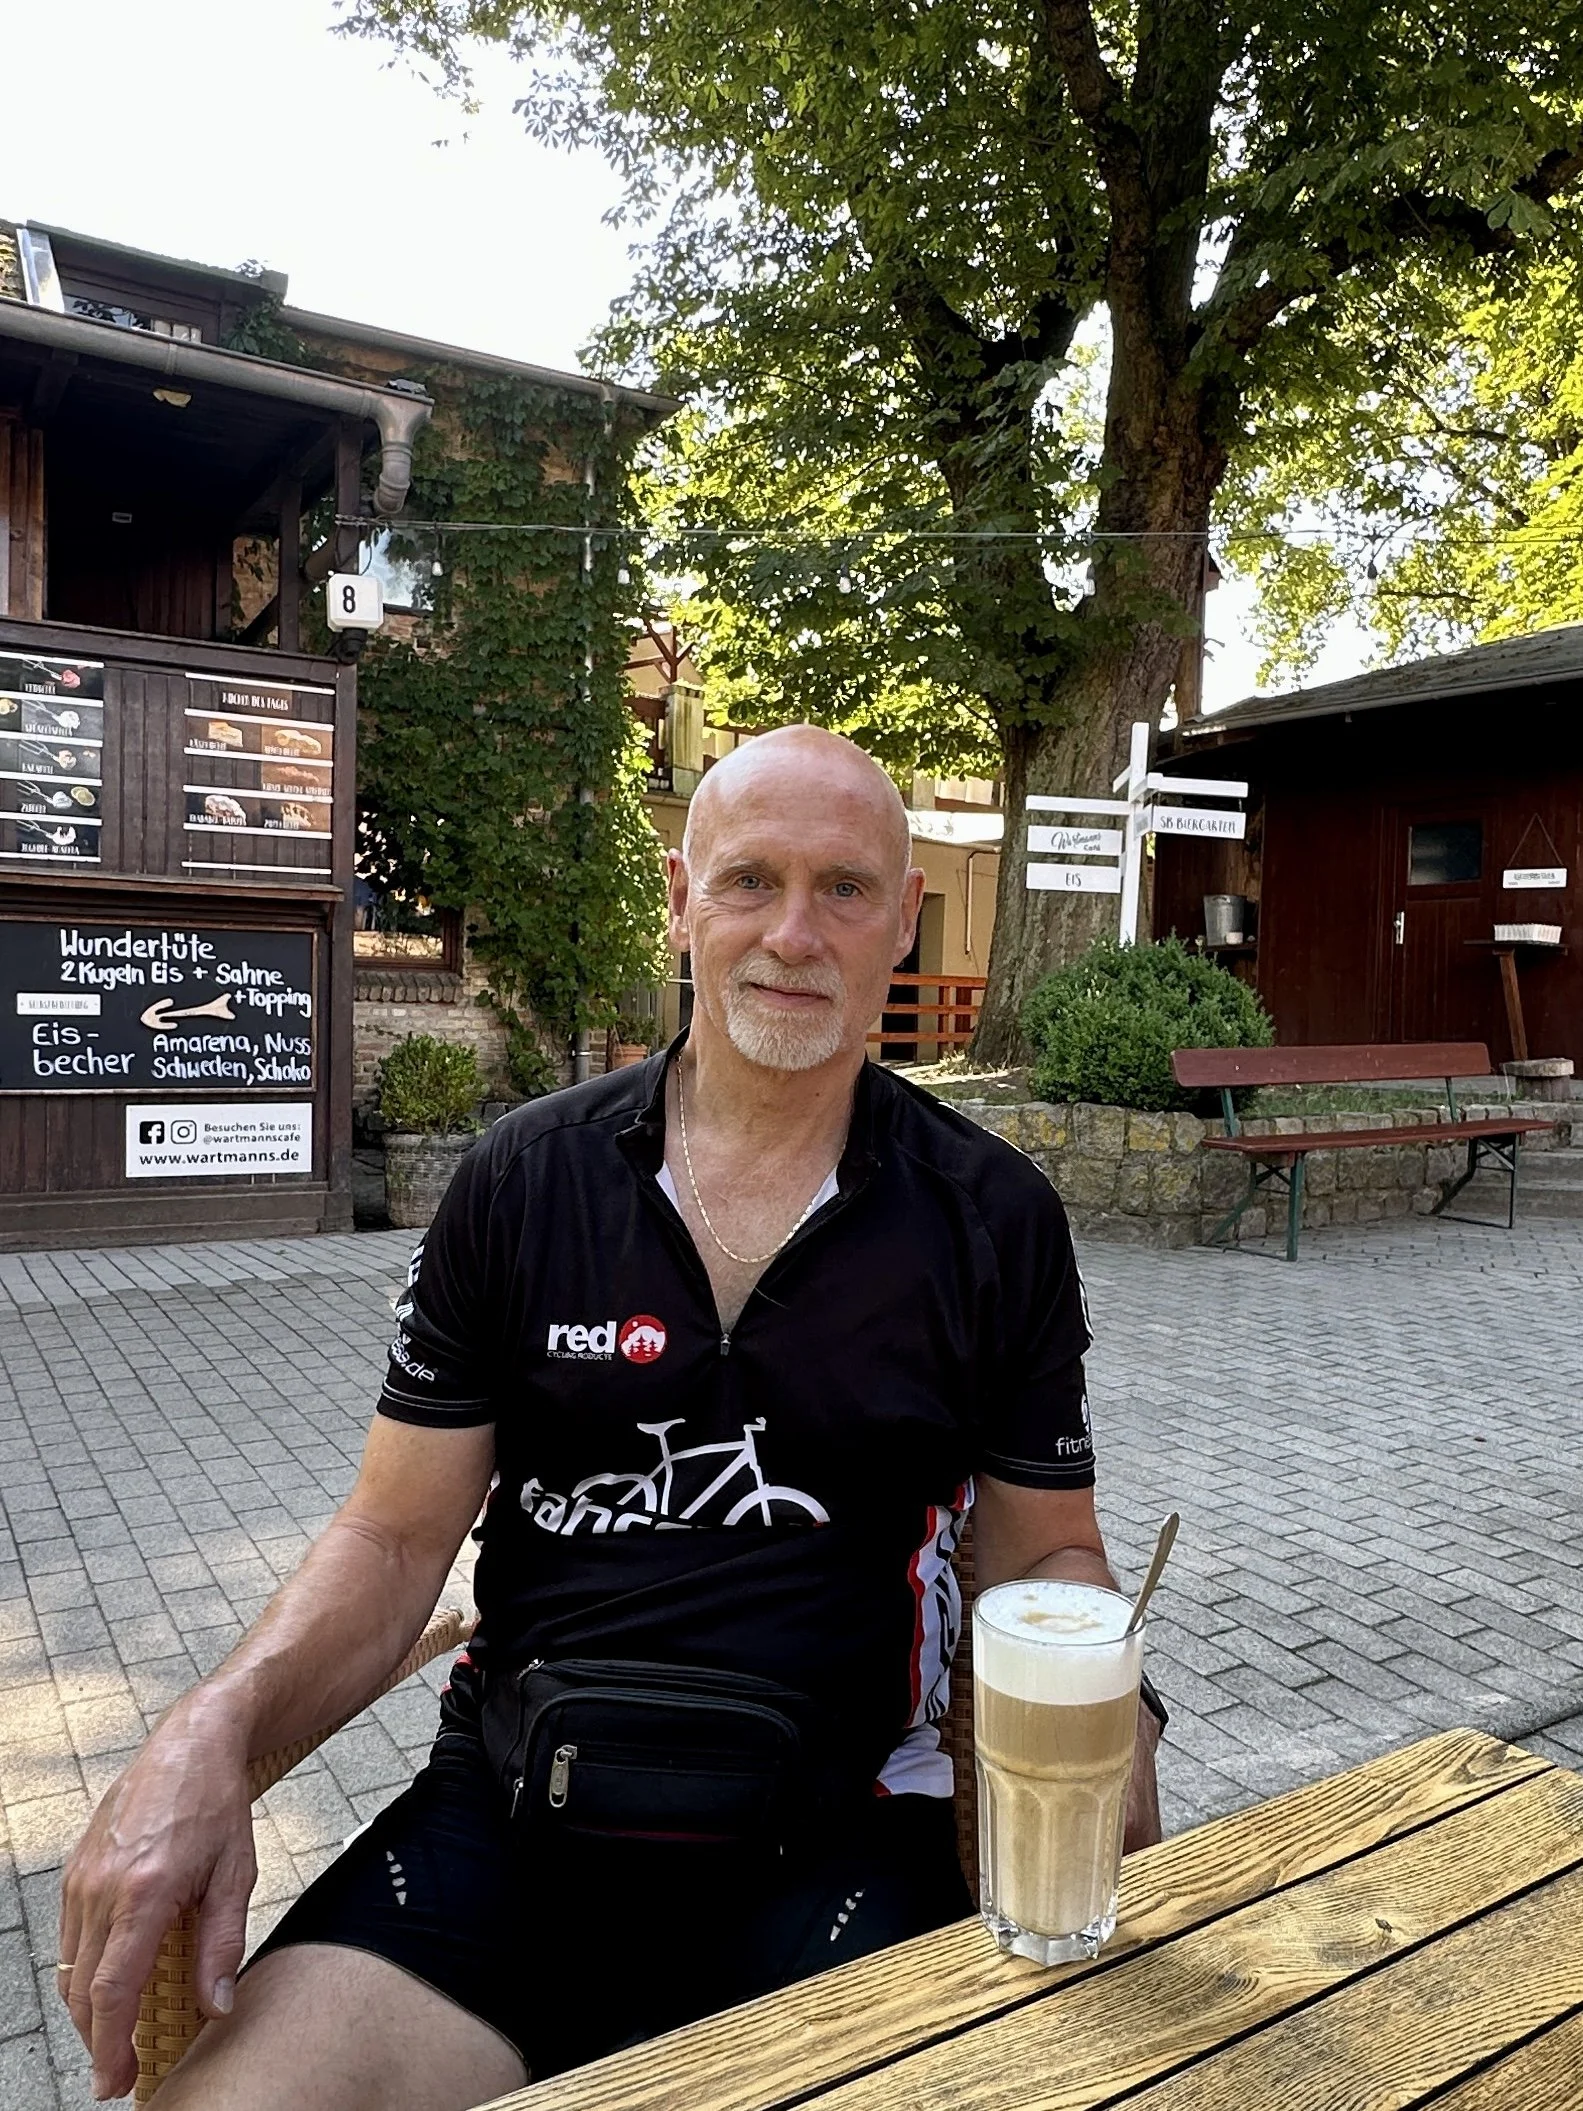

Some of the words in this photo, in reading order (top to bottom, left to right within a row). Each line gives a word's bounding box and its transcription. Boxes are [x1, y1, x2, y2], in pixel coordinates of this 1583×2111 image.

[343, 585, 356, 614] 8
[1066, 872, 1082, 887] EIS
[60, 929, 217, 962] Wundertüte
[151, 961, 184, 984] Eis
[215, 961, 285, 986] Sahne
[153, 1033, 259, 1056] Amarena,
[264, 1032, 311, 1055] Nuss
[33, 1046, 136, 1076] becher
[203, 1133, 301, 1145] @wartmannscafe
[204, 1123, 256, 1132] Besuchen
[259, 1122, 276, 1131] Sie
[139, 1148, 300, 1165] www.wartmanns.de
[547, 1321, 617, 1353] red
